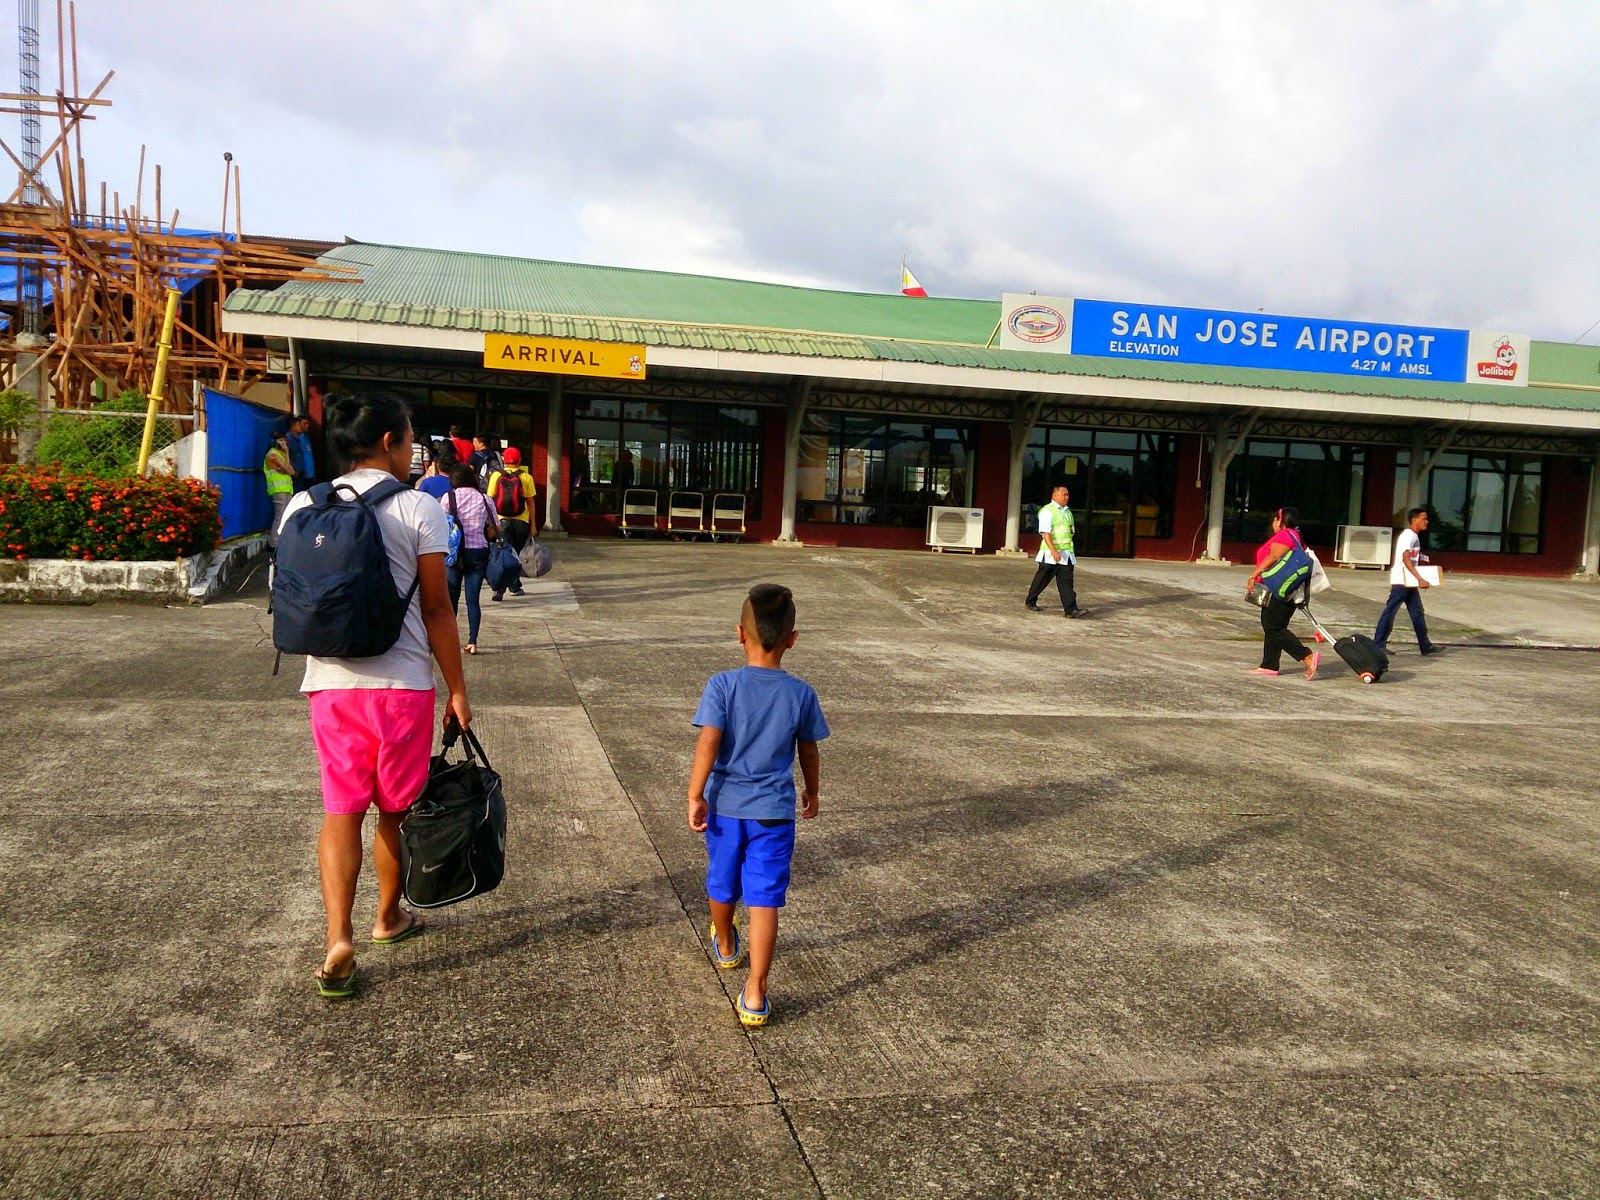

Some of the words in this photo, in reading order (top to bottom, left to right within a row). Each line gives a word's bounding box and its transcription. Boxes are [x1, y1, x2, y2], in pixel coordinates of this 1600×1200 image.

[1111, 311, 1178, 340] SAN
[1195, 318, 1279, 348] JOSE
[1295, 326, 1436, 359] AIRPORT
[500, 344, 600, 367] ARRIVAL
[1109, 340, 1179, 357] ELEVATION
[1351, 359, 1378, 371] 4.27
[1381, 361, 1391, 372] M
[1399, 362, 1433, 375] AMSL
[1479, 365, 1514, 376] Jollibee
